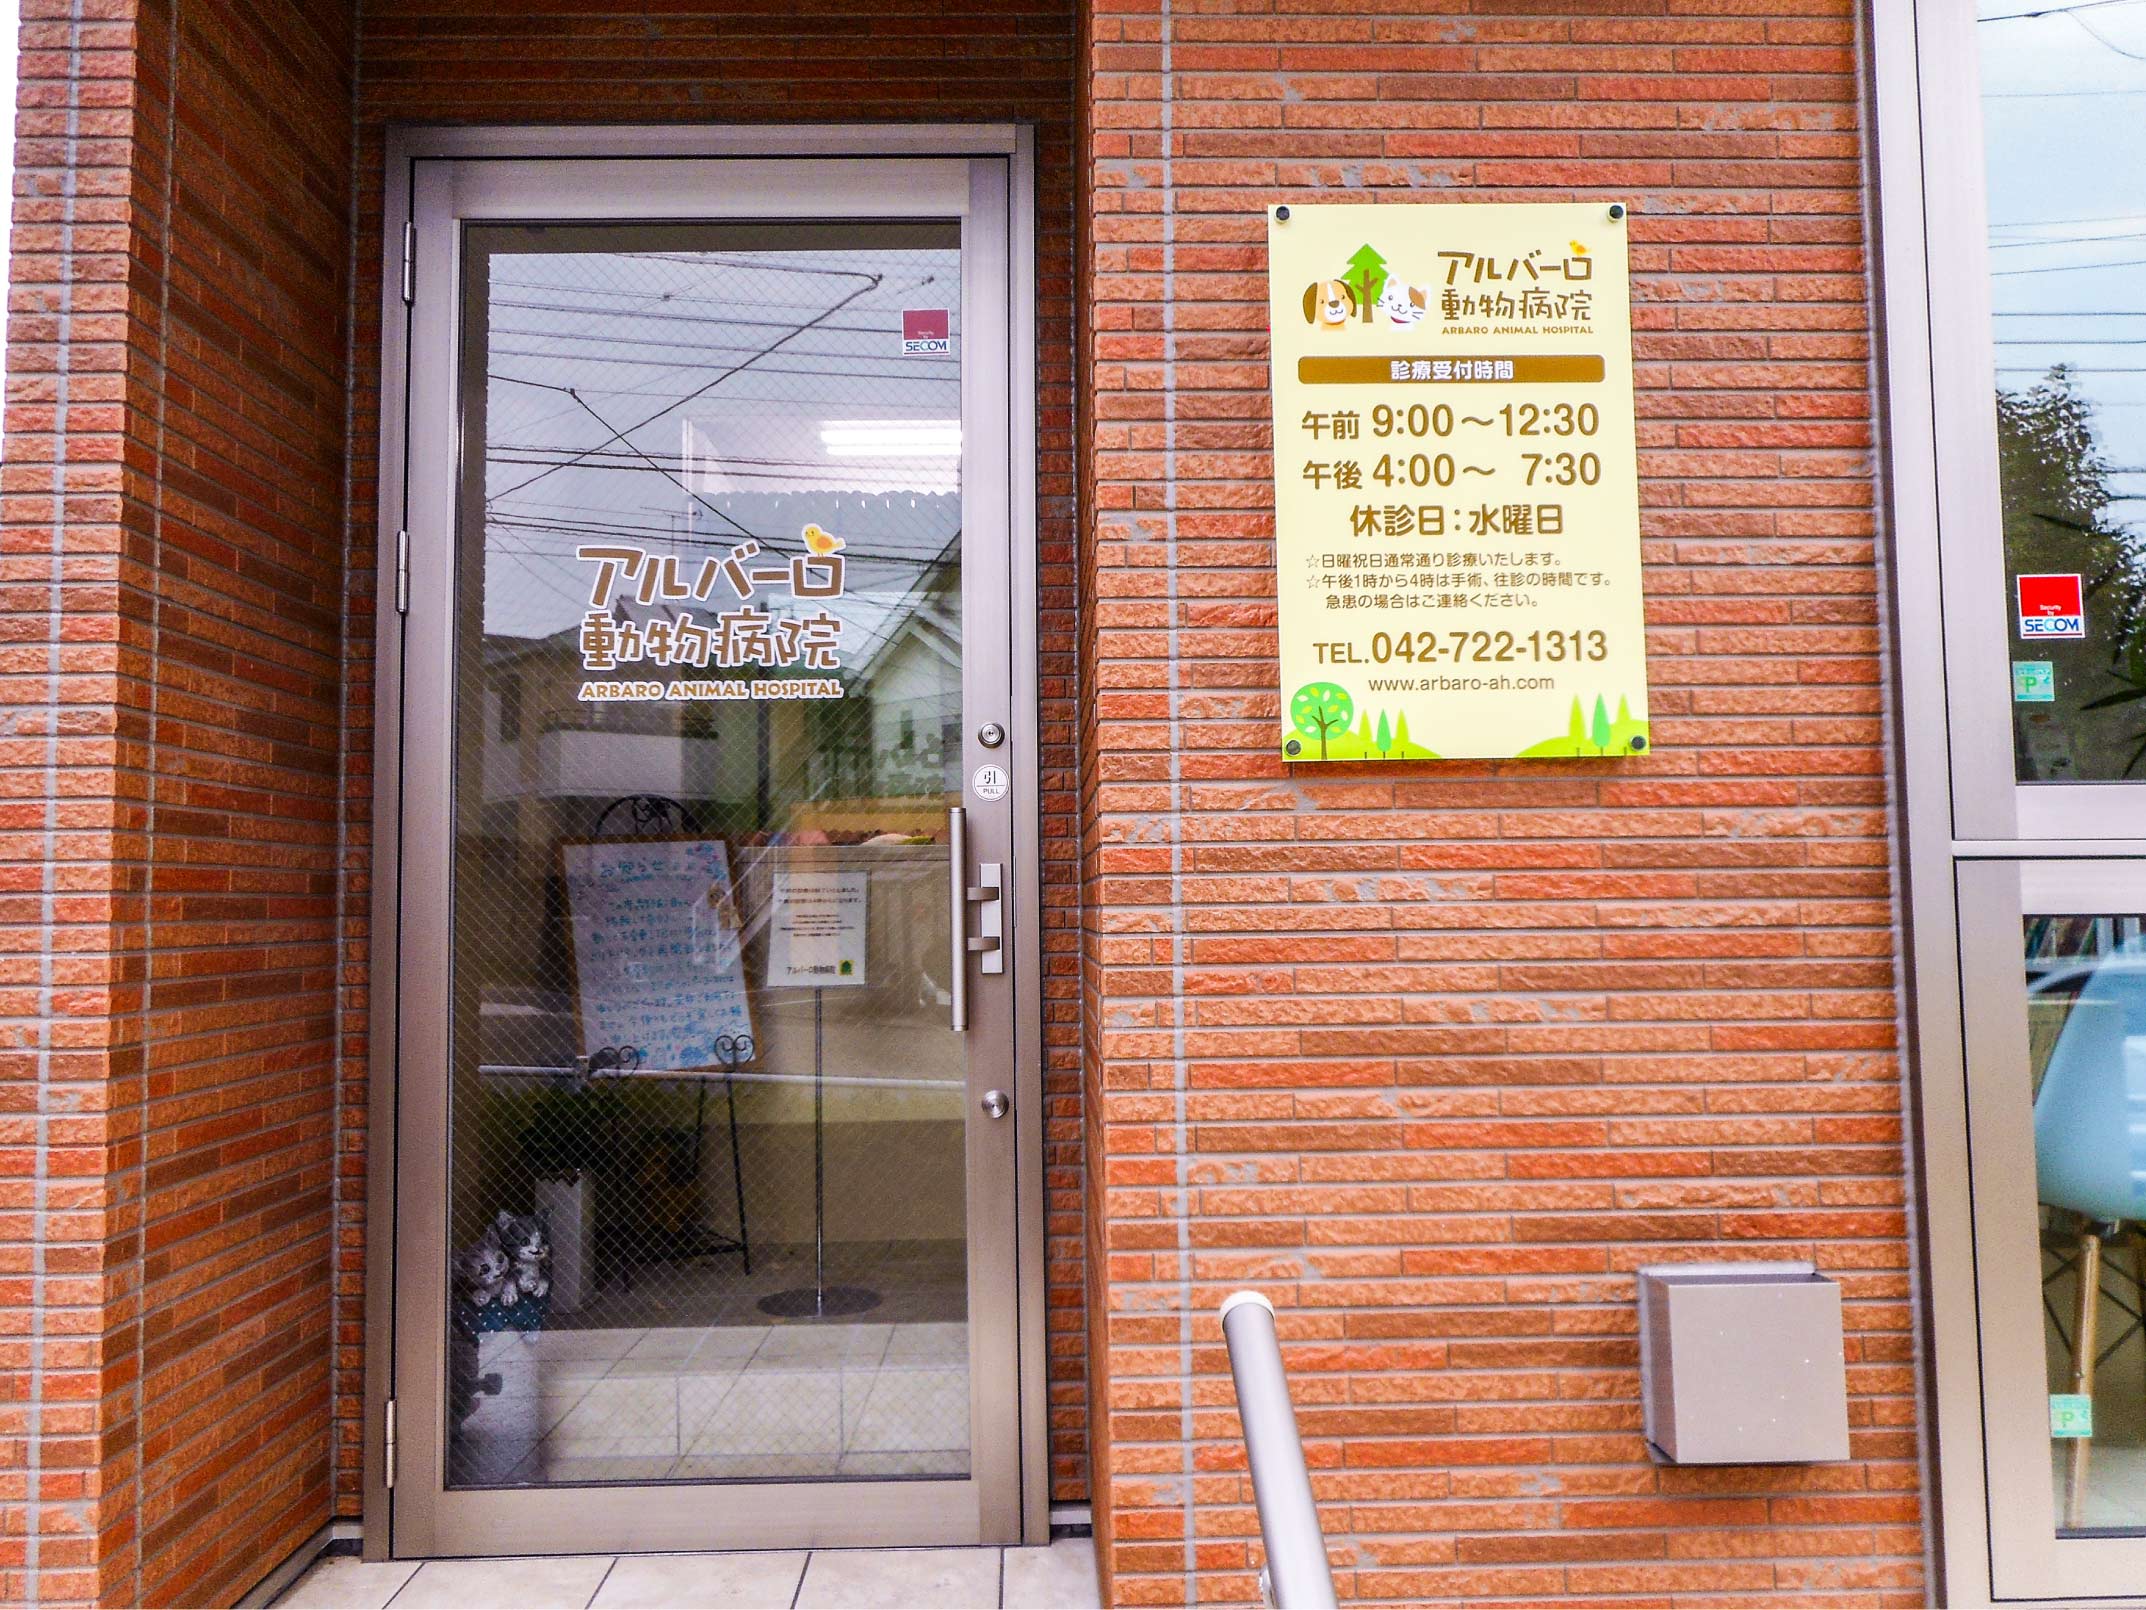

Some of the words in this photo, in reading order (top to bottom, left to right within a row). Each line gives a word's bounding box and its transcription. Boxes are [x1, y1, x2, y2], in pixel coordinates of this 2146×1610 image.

[1437, 249, 1594, 286] アルバーロ
[1441, 286, 1592, 321] 動物病院
[1441, 325, 1489, 335] ARBARO
[1493, 325, 1539, 335] ANIMAL
[1542, 325, 1594, 335] HOSPITAL
[905, 341, 948, 352] SECOM
[1390, 360, 1514, 381] 診療受付時間
[1301, 410, 1361, 440] 午前
[1302, 460, 1363, 490] 午後
[577, 542, 844, 608] アルバーロ
[2025, 618, 2079, 632] SECOM
[582, 606, 842, 668] 動物病院
[580, 682, 662, 699] ARBARO
[667, 681, 747, 698] ANIMAL
[753, 680, 842, 698] HOSPITAL
[1368, 674, 1555, 691] www.arbaro-ah.com
[983, 770, 997, 784] 引
